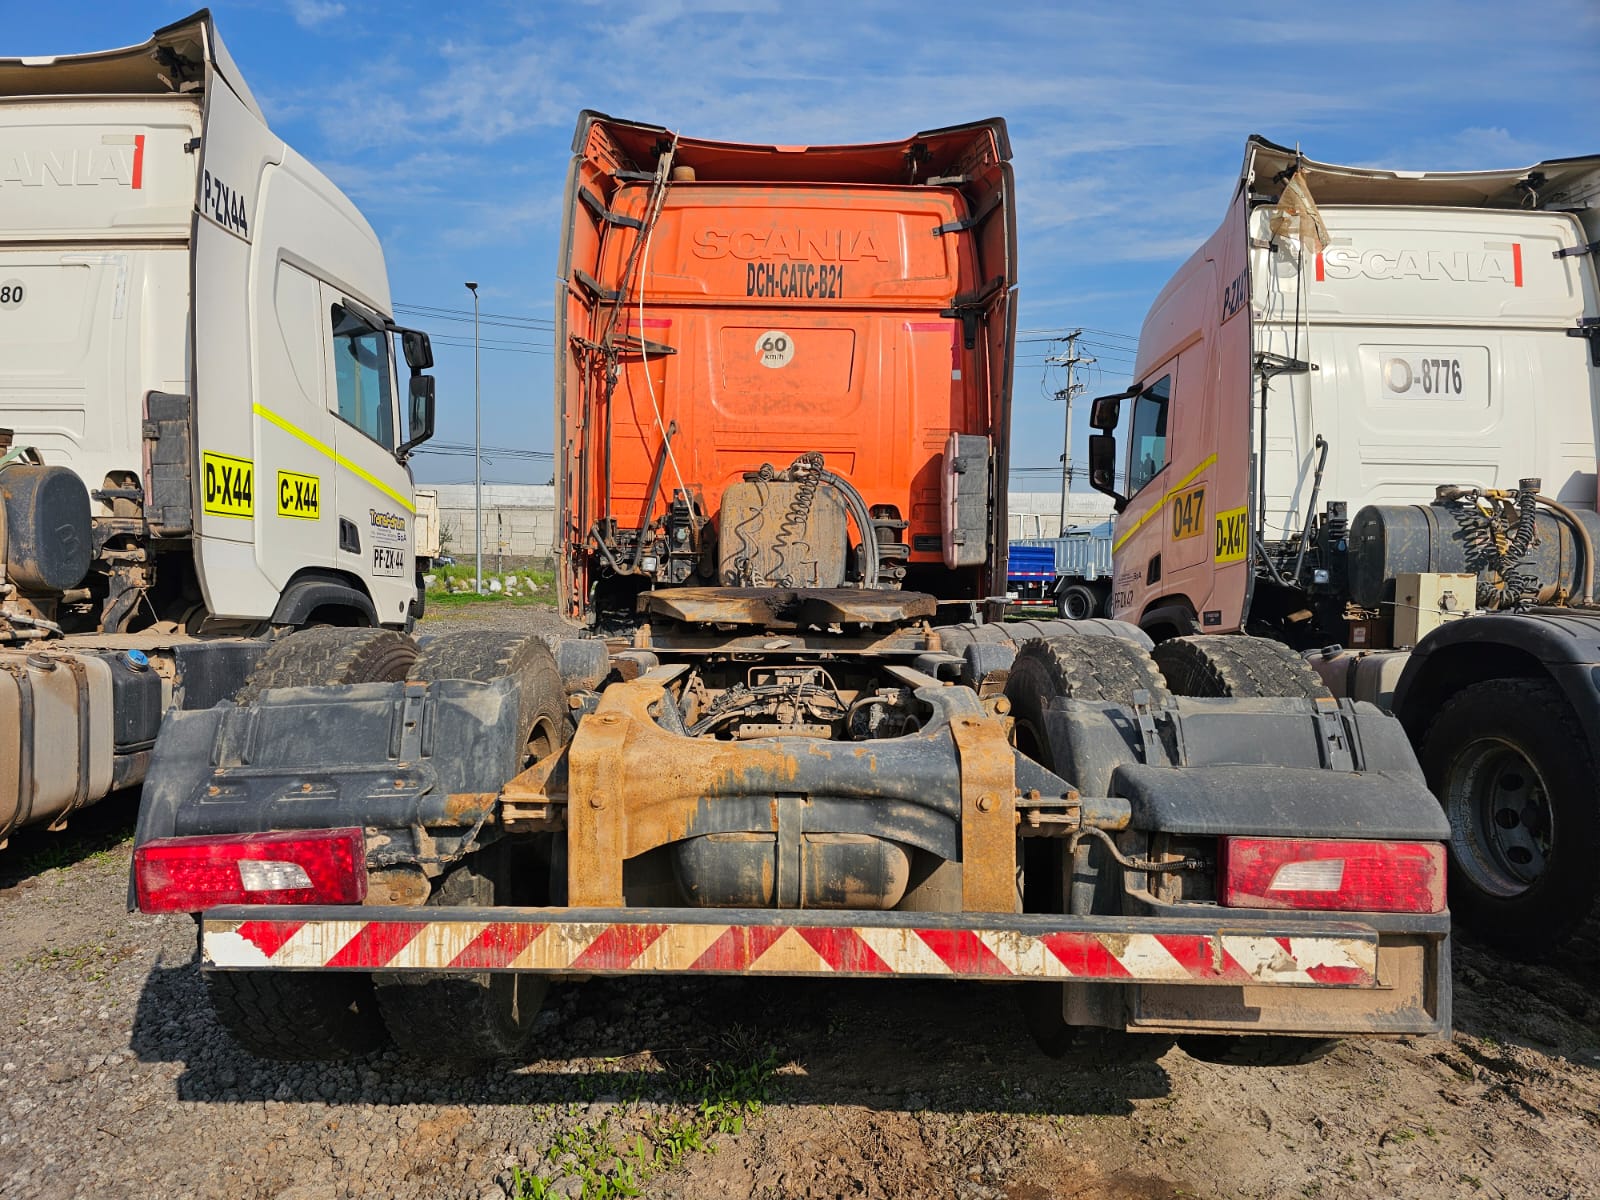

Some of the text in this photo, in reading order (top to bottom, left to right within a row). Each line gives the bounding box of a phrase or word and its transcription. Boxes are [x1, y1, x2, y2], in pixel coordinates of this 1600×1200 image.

[205, 168, 247, 238] P-ZX44
[691, 227, 889, 263] SCANIA
[747, 263, 843, 299] DCH-CATC-B21
[1325, 248, 1514, 283] SCANIA
[0, 286, 23, 303] 80
[762, 337, 787, 352] 60
[206, 462, 252, 508] D-X44
[281, 478, 318, 513] C-X44
[1173, 490, 1205, 537] 047
[1215, 513, 1247, 557] D-X47
